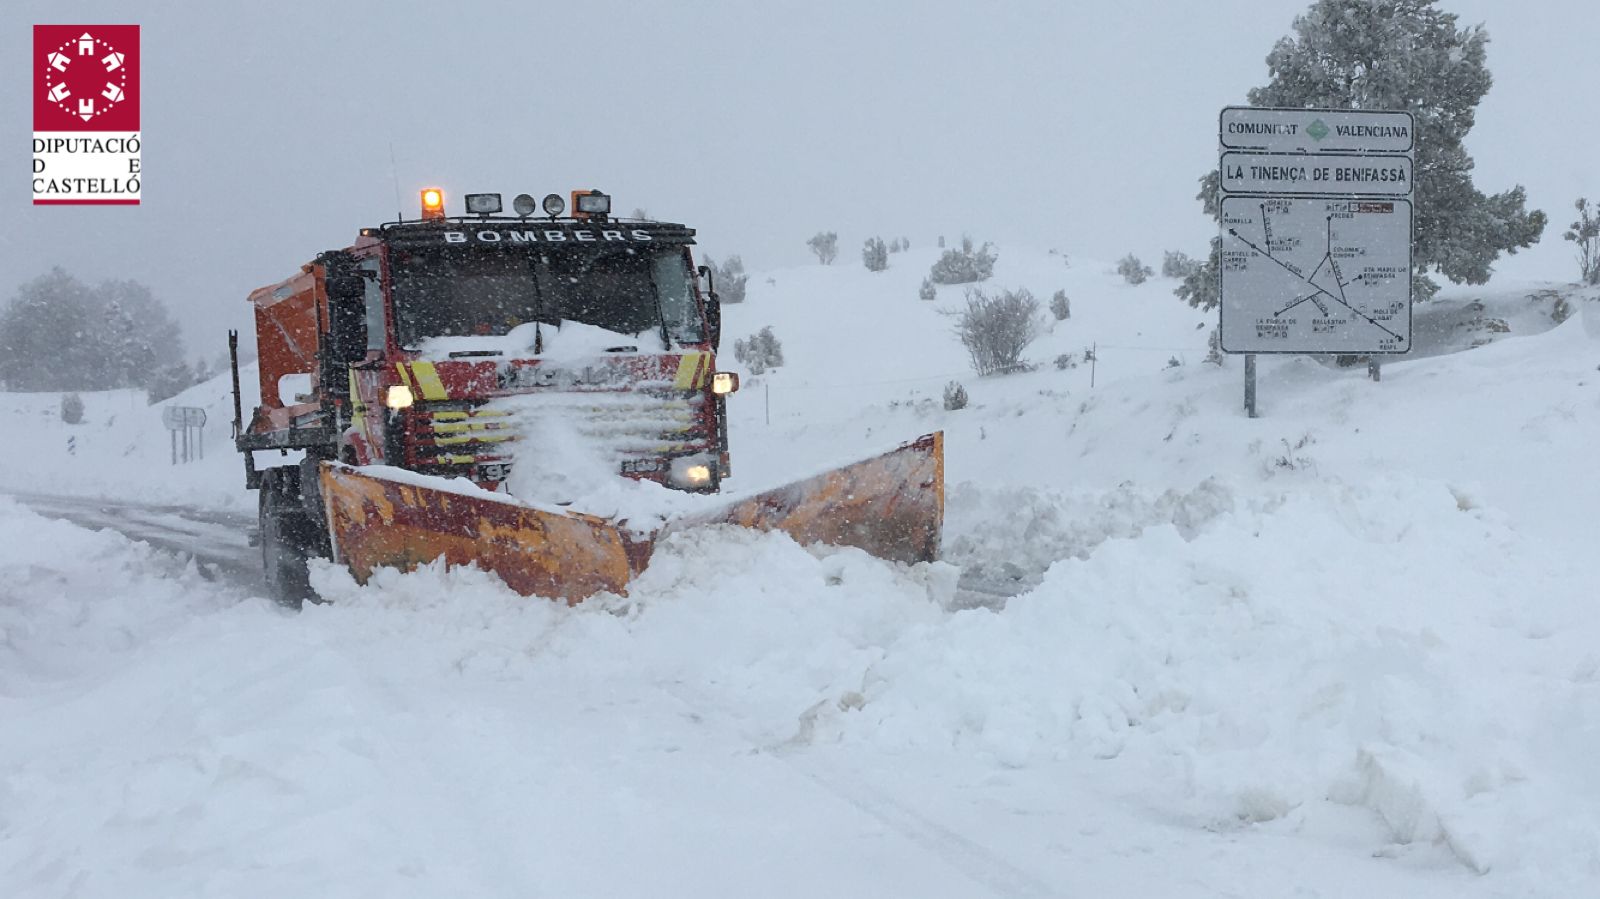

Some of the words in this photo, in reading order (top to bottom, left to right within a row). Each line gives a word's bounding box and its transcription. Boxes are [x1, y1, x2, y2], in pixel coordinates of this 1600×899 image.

[1228, 122, 1298, 135] COMUNITAT
[1336, 125, 1408, 137] VALENCIANA
[1227, 165, 1244, 179] LA
[1251, 166, 1307, 183] TINENÇA
[1313, 168, 1330, 180] DE
[1335, 165, 1406, 182] BENIFASSÀ
[444, 229, 653, 243] BOMBERS
